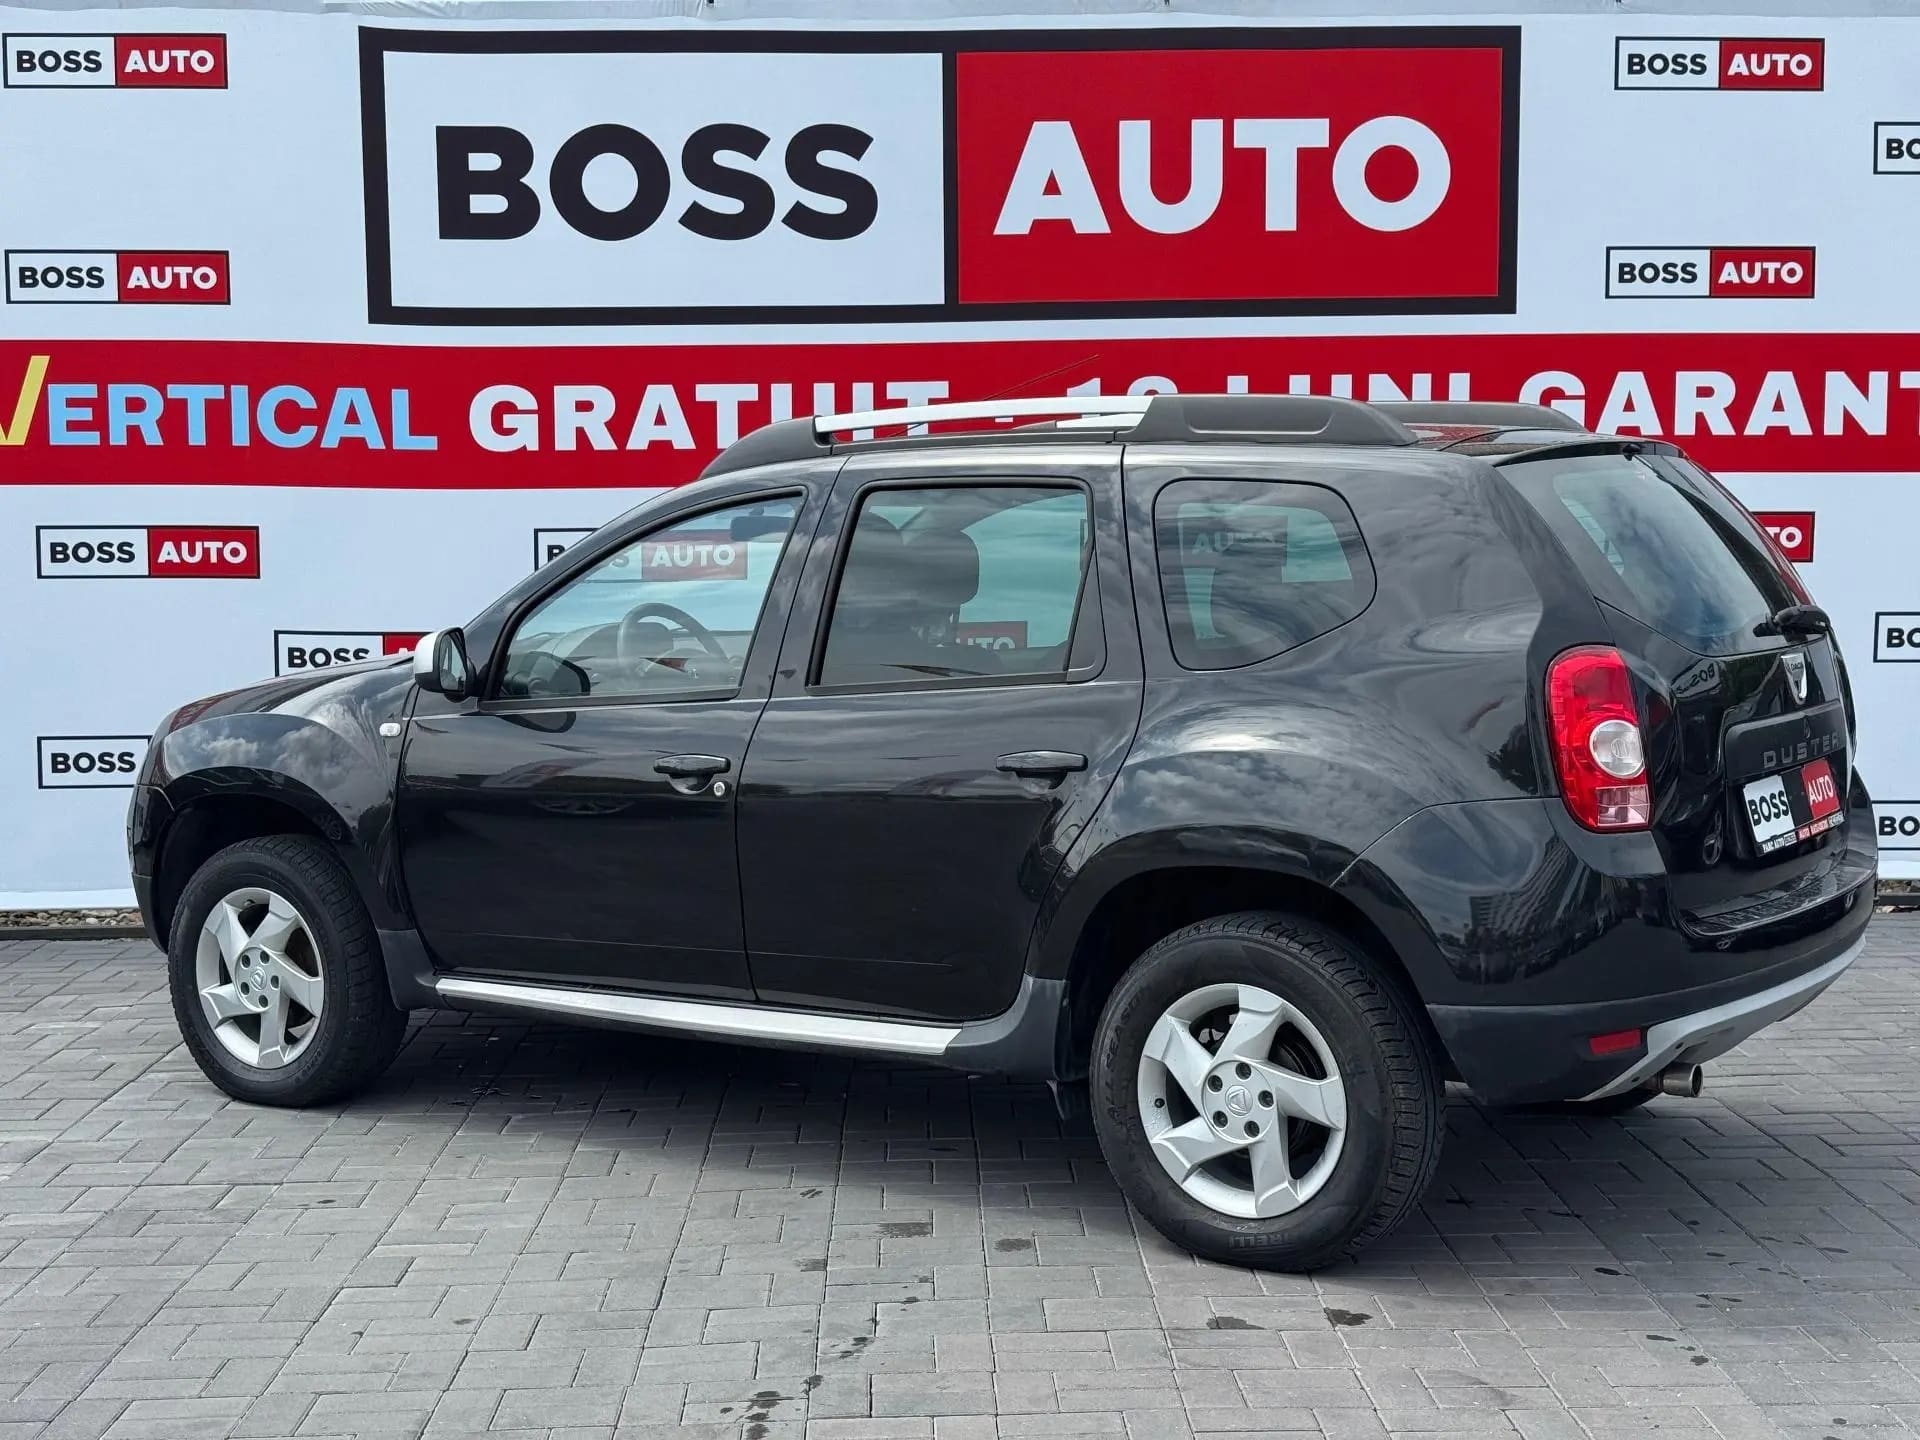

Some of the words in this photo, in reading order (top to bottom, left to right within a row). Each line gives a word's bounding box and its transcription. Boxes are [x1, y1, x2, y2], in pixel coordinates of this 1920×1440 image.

[16, 50, 102, 74] BOSS
[124, 50, 215, 74] AUTO
[1627, 53, 1708, 77] BOSS
[1727, 53, 1813, 77] AUTO
[436, 123, 879, 242] BOSS
[994, 115, 1451, 237] AUTO
[18, 266, 105, 290] BOSS
[127, 267, 218, 291] AUTO
[1618, 262, 1699, 285] BOSS
[1719, 262, 1804, 285] AUTO
[49, 541, 136, 564] BOSS
[157, 541, 248, 564] AUTO
[651, 545, 736, 568] AUTO
[1763, 731, 1839, 769] DUSTER
[50, 751, 136, 774] BOSS
[1747, 790, 1790, 826] BOSS
[1807, 775, 1834, 805] AUTO
